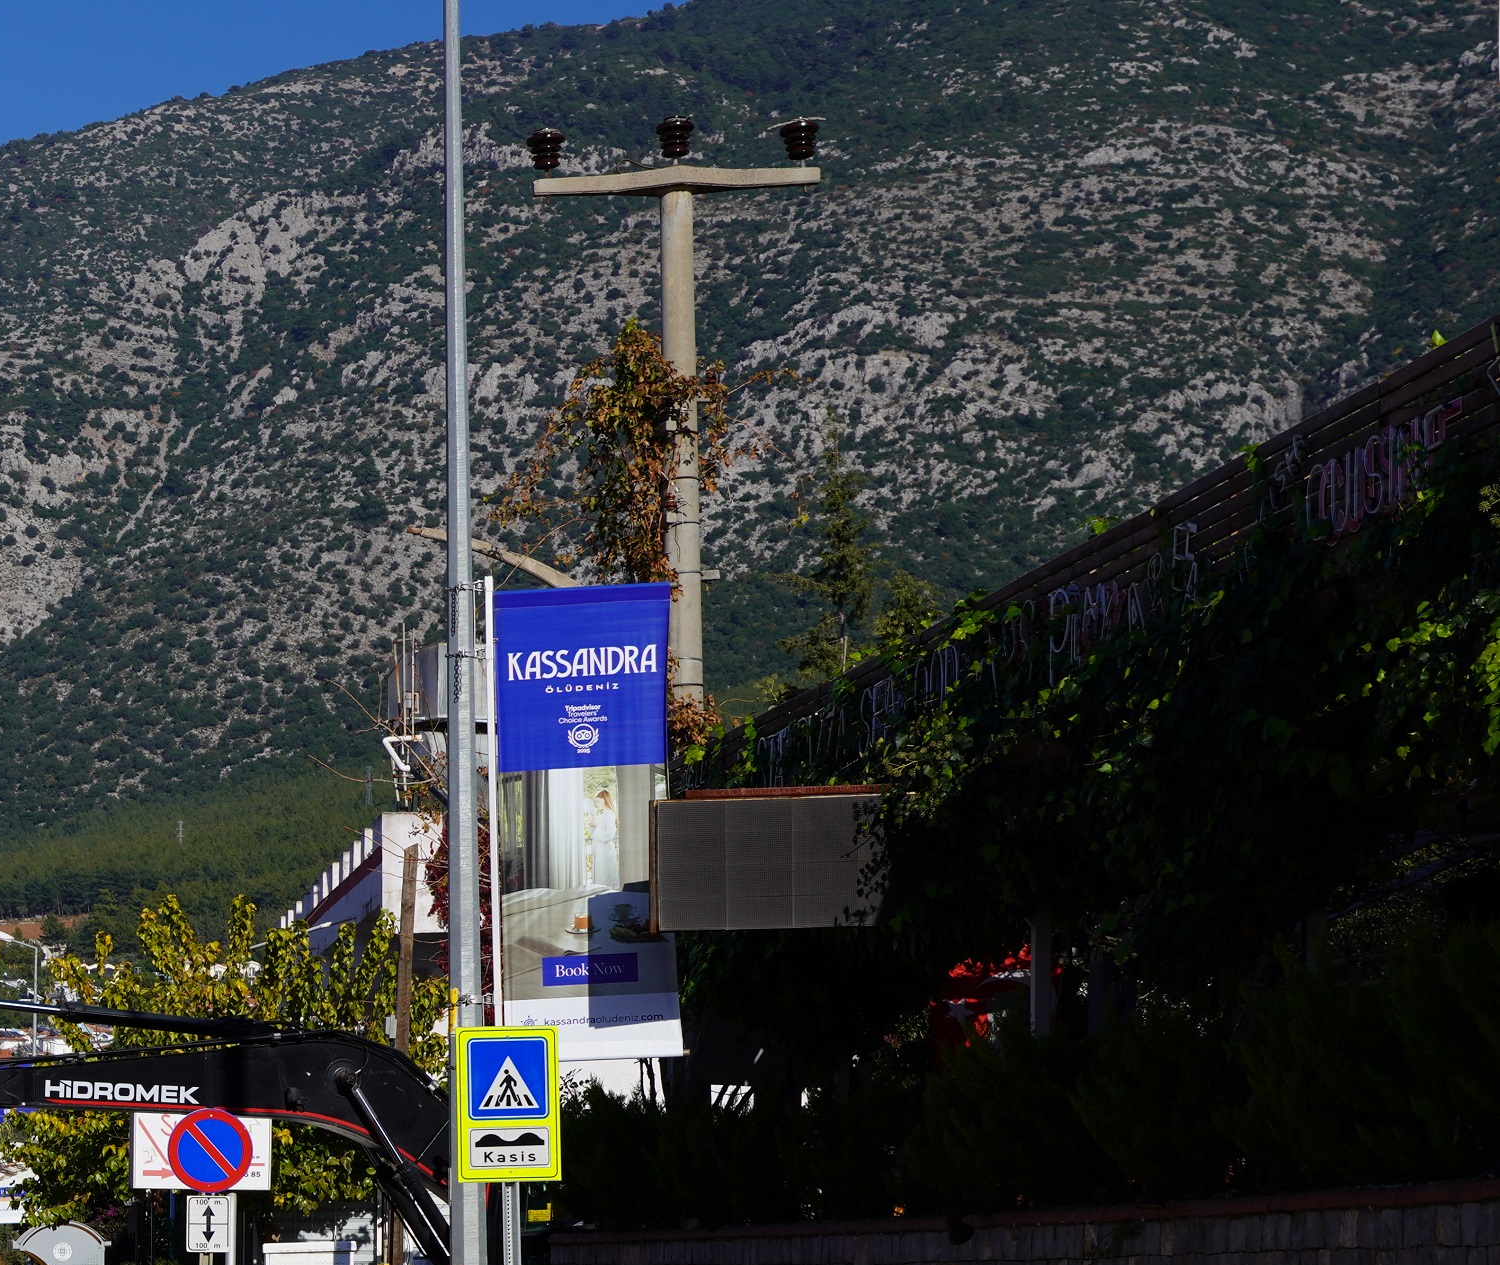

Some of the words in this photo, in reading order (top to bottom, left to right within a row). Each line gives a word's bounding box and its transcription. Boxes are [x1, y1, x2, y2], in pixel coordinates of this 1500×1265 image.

[507, 644, 657, 681] KASSANDRA
[545, 682, 619, 694] ÖLÜDENİZ
[565, 704, 601, 712] Tripadvisor
[558, 716, 582, 724] Choice
[555, 963, 589, 978] Book
[593, 961, 625, 976] Now
[544, 1013, 664, 1026] kassandraoludeniz.com
[484, 1151, 536, 1163] Kasis
